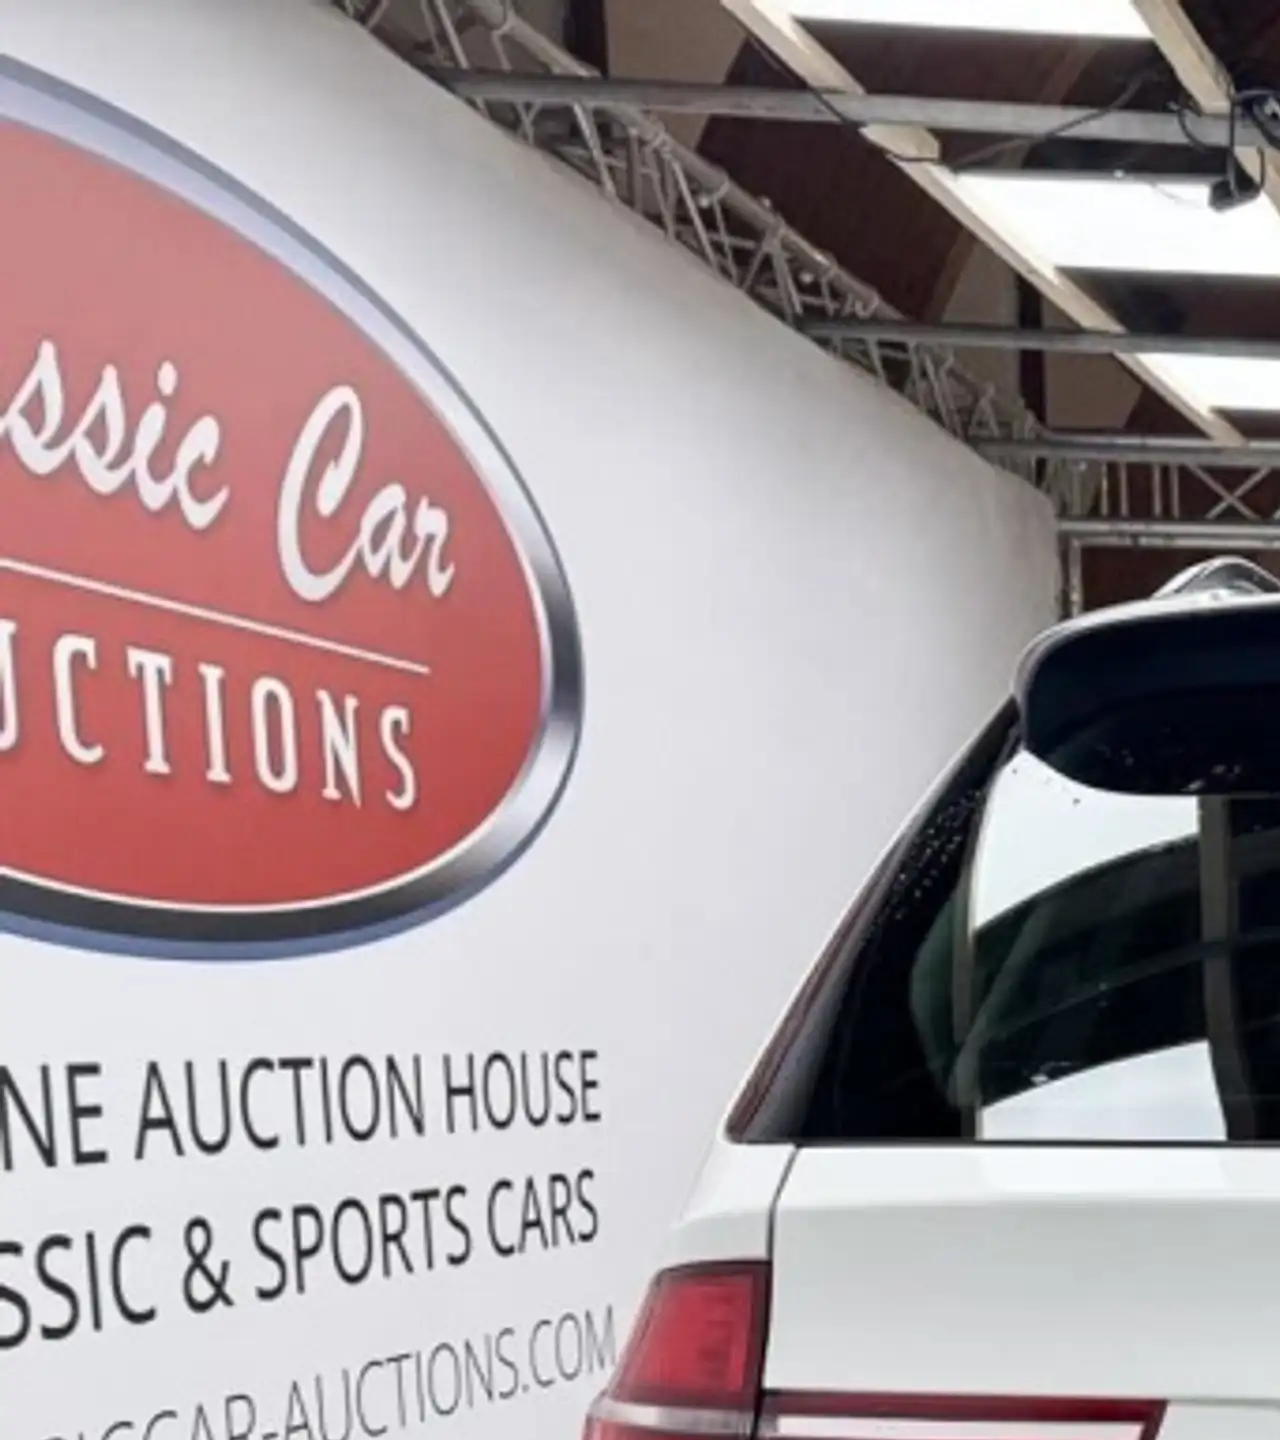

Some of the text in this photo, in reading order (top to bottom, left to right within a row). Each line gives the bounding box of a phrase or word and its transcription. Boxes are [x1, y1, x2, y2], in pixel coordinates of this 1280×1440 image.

[277, 384, 454, 601] Car
[135, 1053, 426, 1160] AUCTION
[442, 1049, 602, 1134] HOUSE
[181, 1216, 235, 1313] &
[252, 1184, 472, 1302] SPORTS
[486, 1168, 600, 1257] CARS
